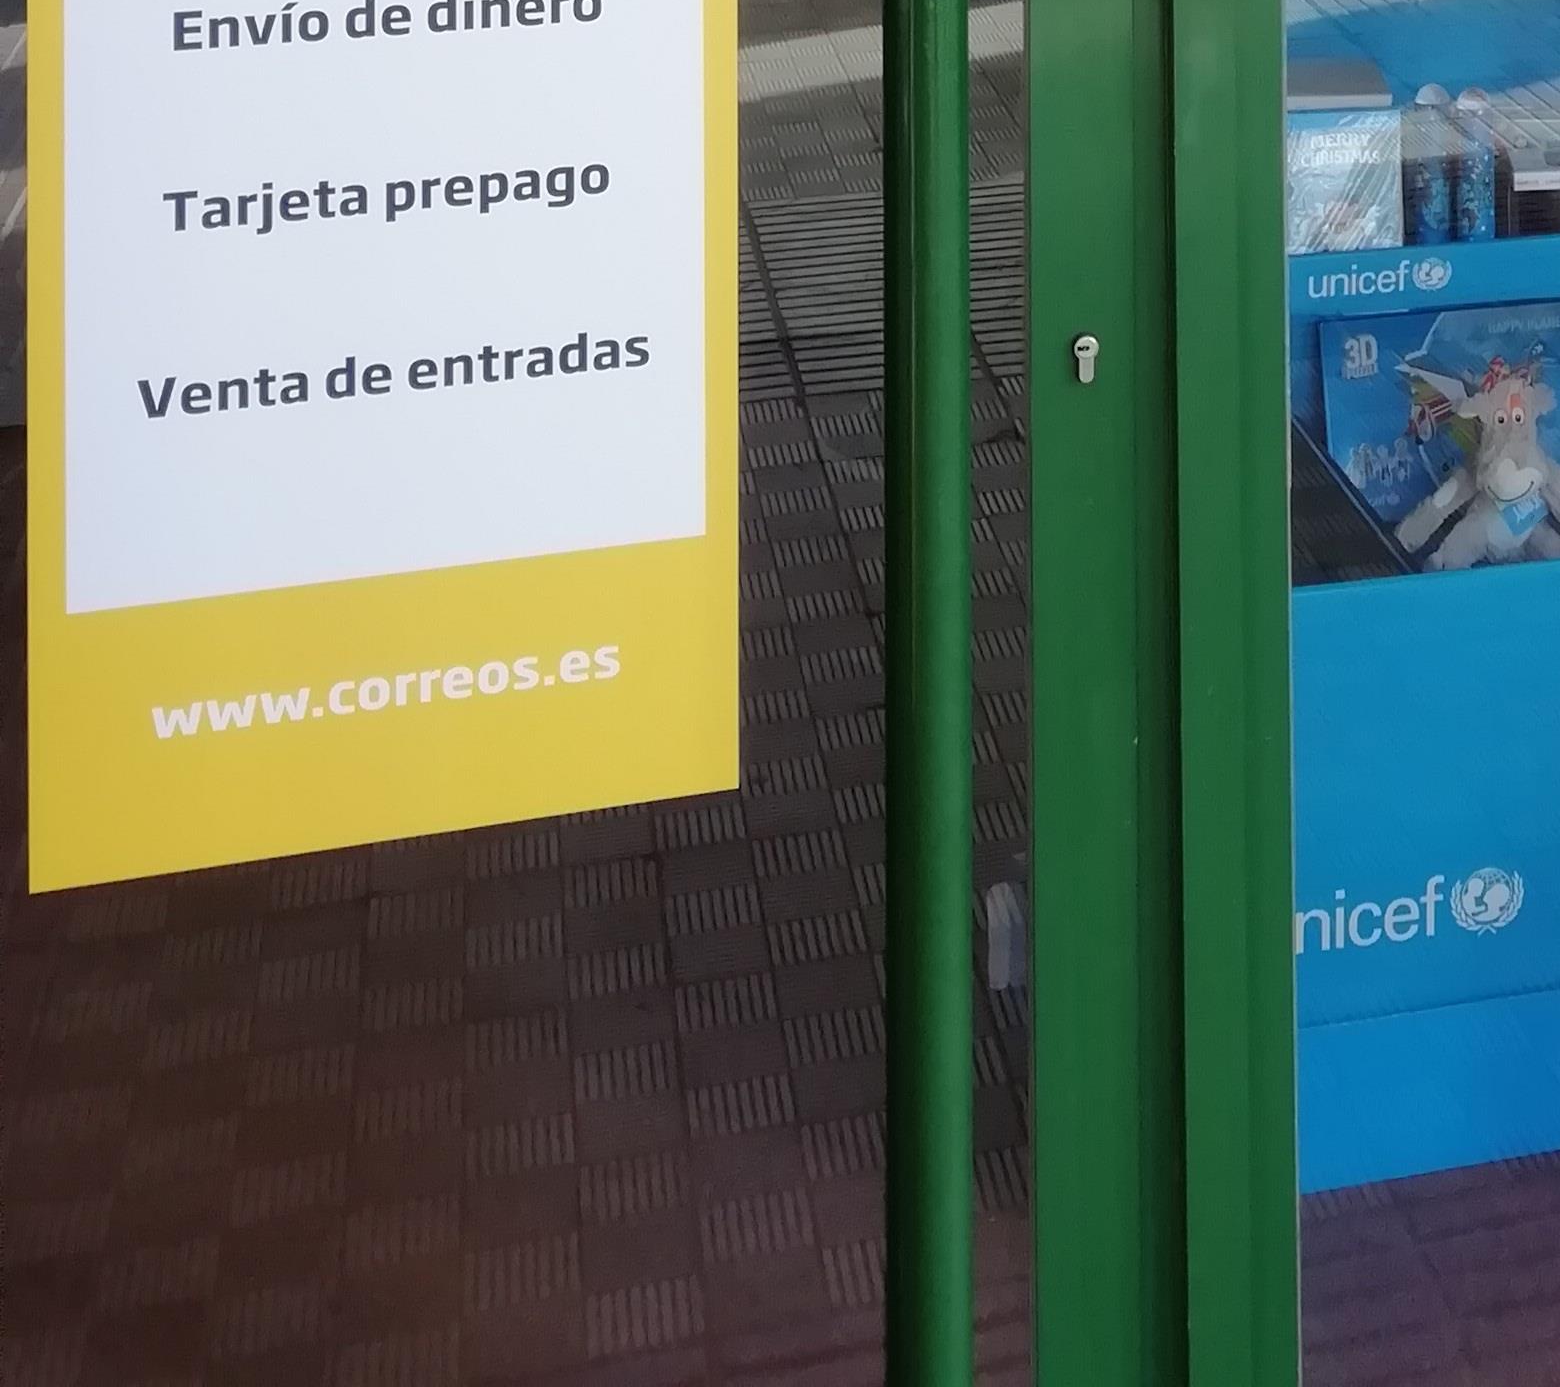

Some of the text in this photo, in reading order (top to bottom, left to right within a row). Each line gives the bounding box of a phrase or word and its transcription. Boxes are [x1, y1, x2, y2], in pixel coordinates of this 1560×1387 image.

[172, 1, 330, 52] Envío
[1299, 149, 1381, 167] CHRISTMAS
[1310, 133, 1372, 149] MERRY
[163, 161, 611, 235] Tarjeta prepago
[1307, 259, 1410, 299] unicef
[137, 332, 652, 419] Venta de entradas
[1343, 333, 1378, 369] 3D
[151, 643, 622, 740] www.correos.es
[1295, 873, 1445, 955] nicef
